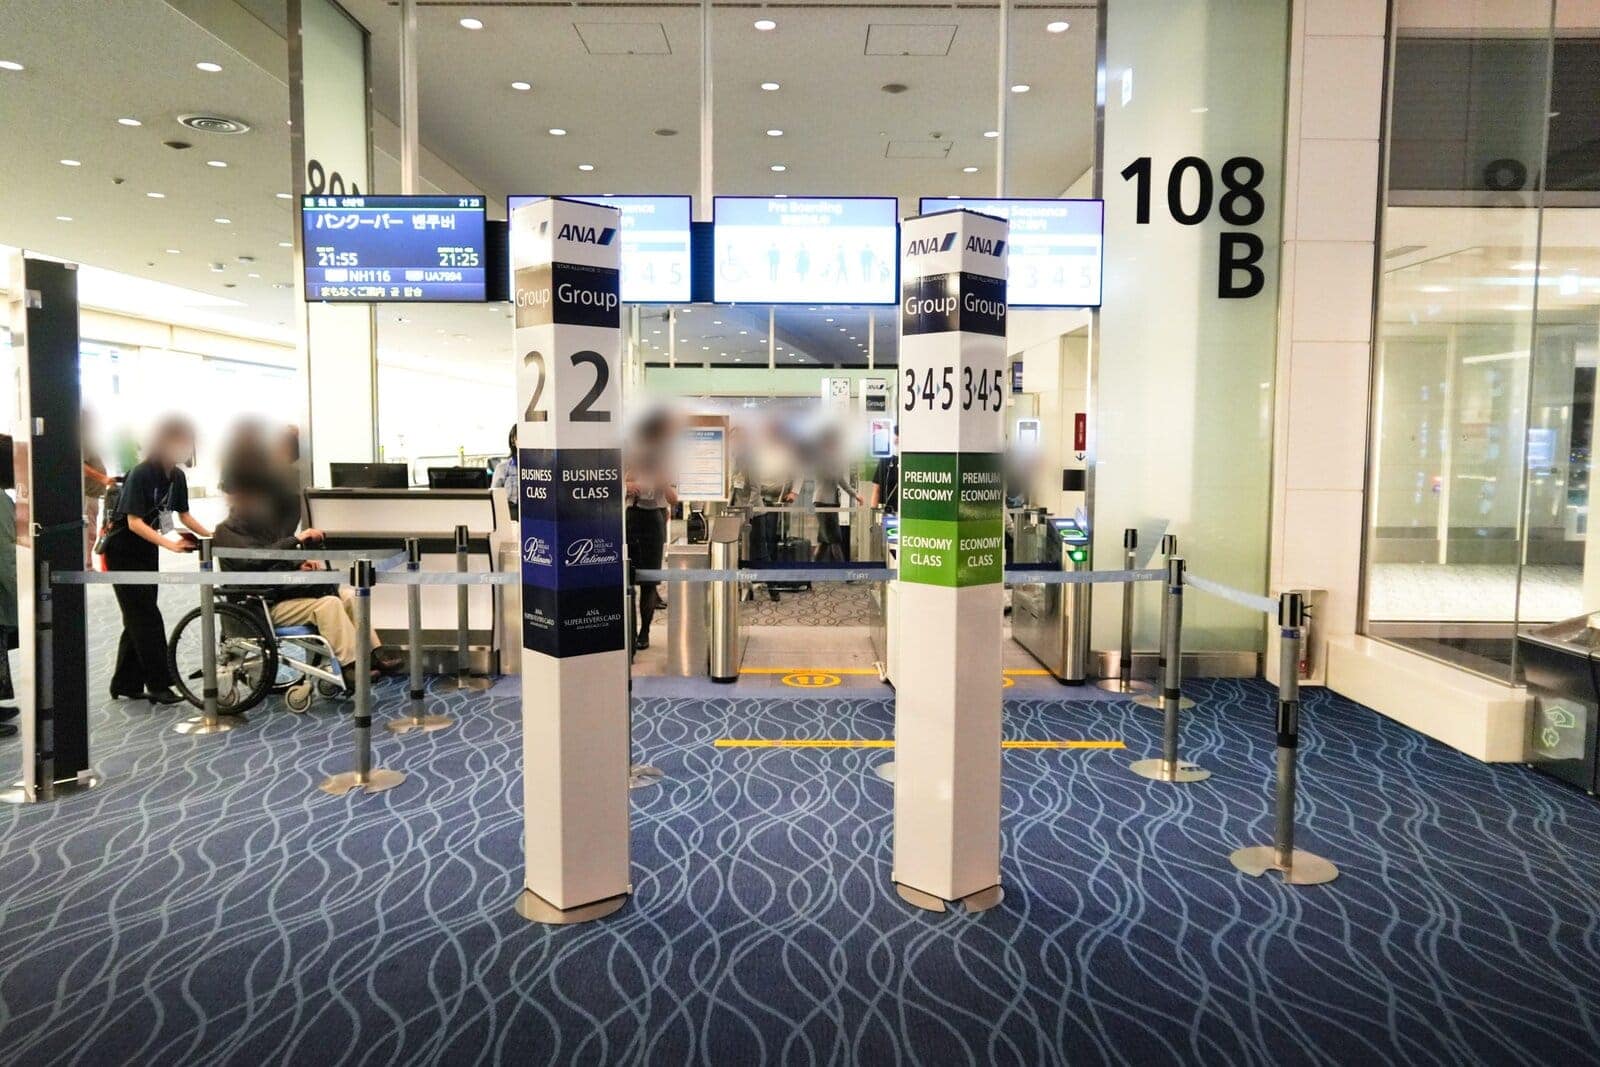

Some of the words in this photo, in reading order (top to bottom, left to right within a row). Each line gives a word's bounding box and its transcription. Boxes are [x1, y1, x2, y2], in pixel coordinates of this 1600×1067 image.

[1121, 156, 1265, 226] 108
[316, 213, 404, 230] バンクーバー
[558, 223, 596, 245] ANA
[907, 237, 939, 257] ANA
[966, 235, 993, 256] ANA
[318, 252, 358, 267] 21:55
[439, 253, 479, 267] 21:25
[1218, 232, 1265, 299] B
[349, 270, 392, 283] NH116
[516, 287, 551, 308] Group
[558, 283, 618, 312] Group
[905, 296, 958, 316] Group
[964, 292, 1006, 321] Group
[524, 350, 548, 422] 2
[569, 350, 612, 422] 2
[521, 468, 552, 482] BUSINESS
[562, 468, 618, 482] BUSINESS
[904, 471, 952, 484] PREMIUM
[962, 472, 1001, 484] PREMIUM
[526, 486, 547, 499] CLASS
[572, 486, 609, 499] CLASS
[902, 488, 953, 501] ECONOMY
[961, 489, 1002, 502] ECONOMY
[902, 536, 953, 551] ECONOMY
[960, 537, 1001, 551] ECONOMY
[565, 538, 619, 567] Platinum
[911, 553, 942, 567] CLASS
[967, 554, 994, 567] CLASS
